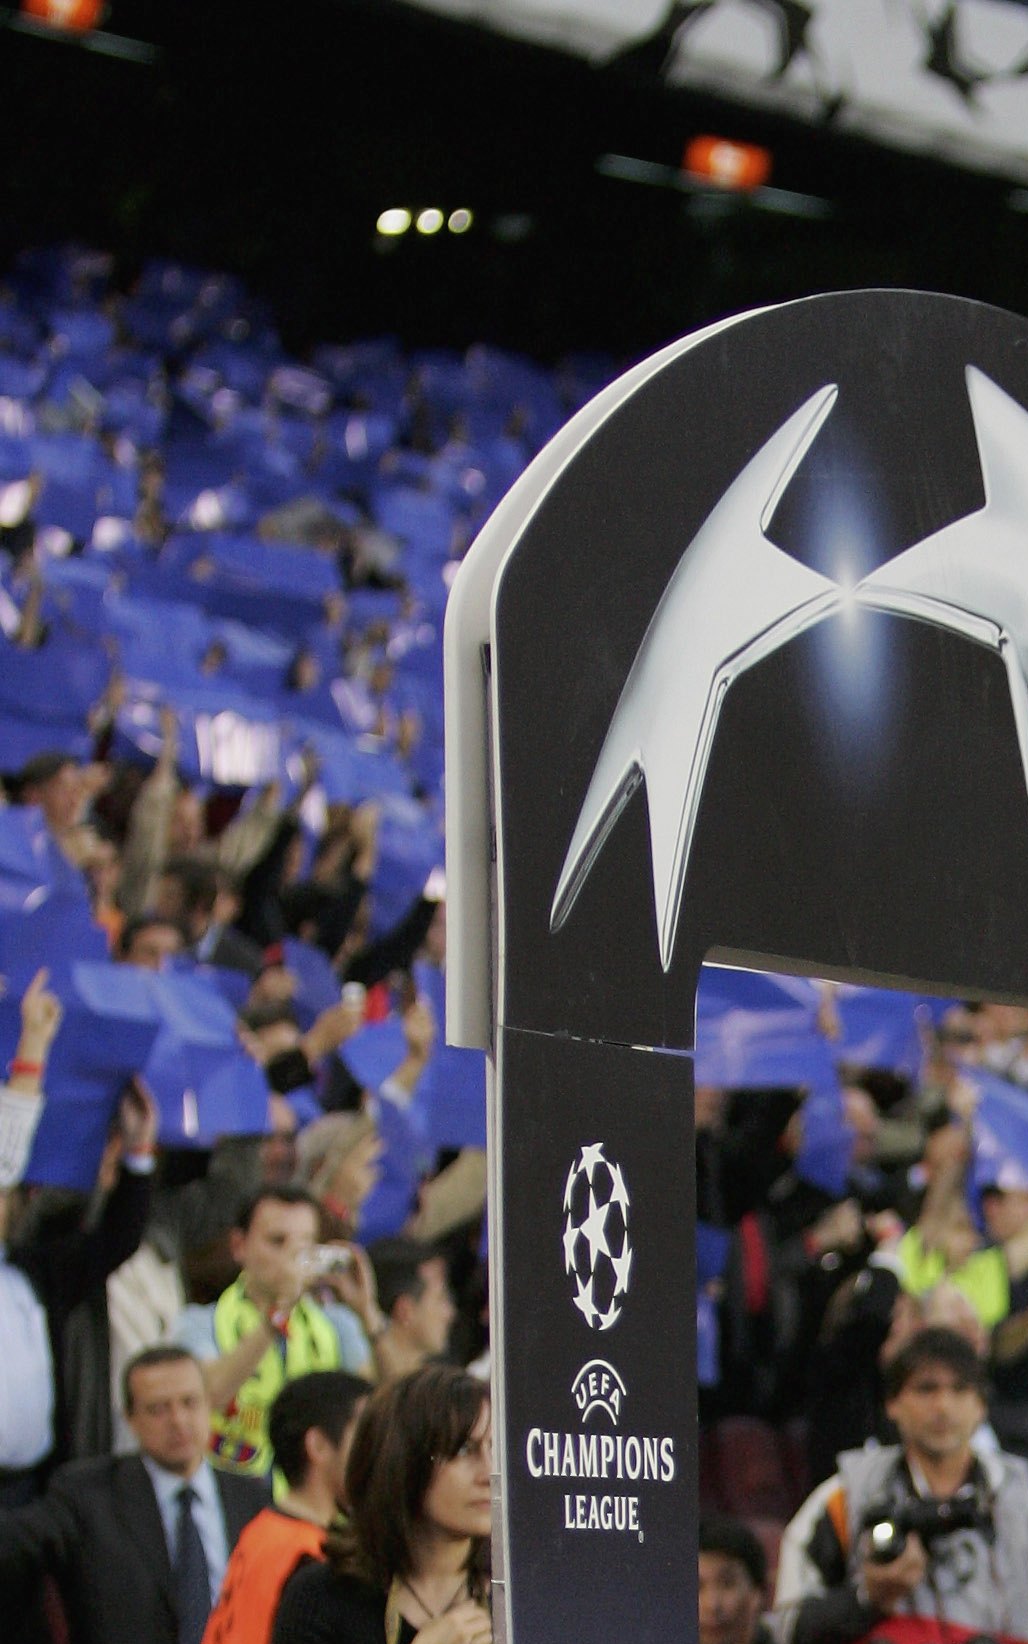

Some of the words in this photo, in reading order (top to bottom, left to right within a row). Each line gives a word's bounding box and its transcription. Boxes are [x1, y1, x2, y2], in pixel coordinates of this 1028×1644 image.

[575, 1372, 621, 1416] UEFA
[525, 1426, 676, 1483] CHAMPIONS
[563, 1493, 640, 1532] LEAGUE
